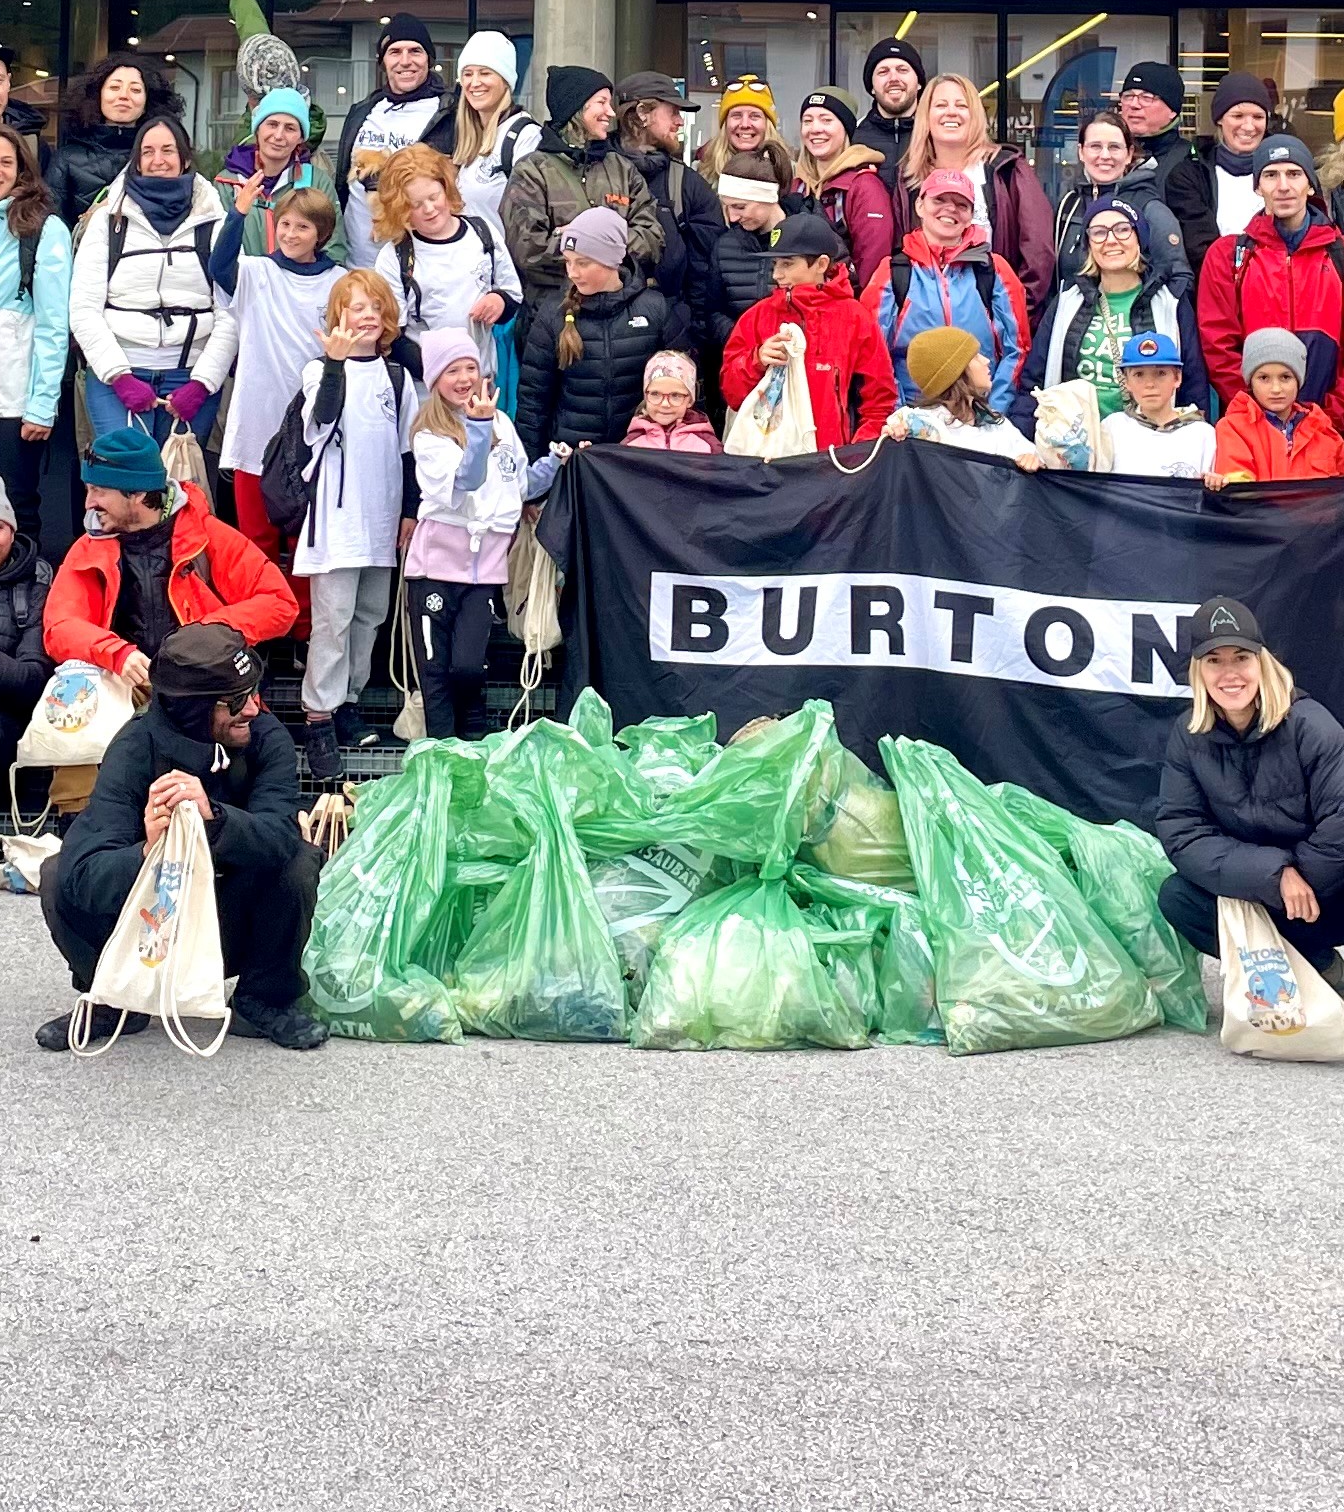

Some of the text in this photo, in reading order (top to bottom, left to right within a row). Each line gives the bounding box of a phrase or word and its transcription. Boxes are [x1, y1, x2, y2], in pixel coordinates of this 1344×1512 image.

[1088, 312, 1133, 335] SEL
[670, 583, 1196, 686] BURTON
[637, 846, 701, 891] SAUBÄR
[327, 1020, 377, 1038] ATM
